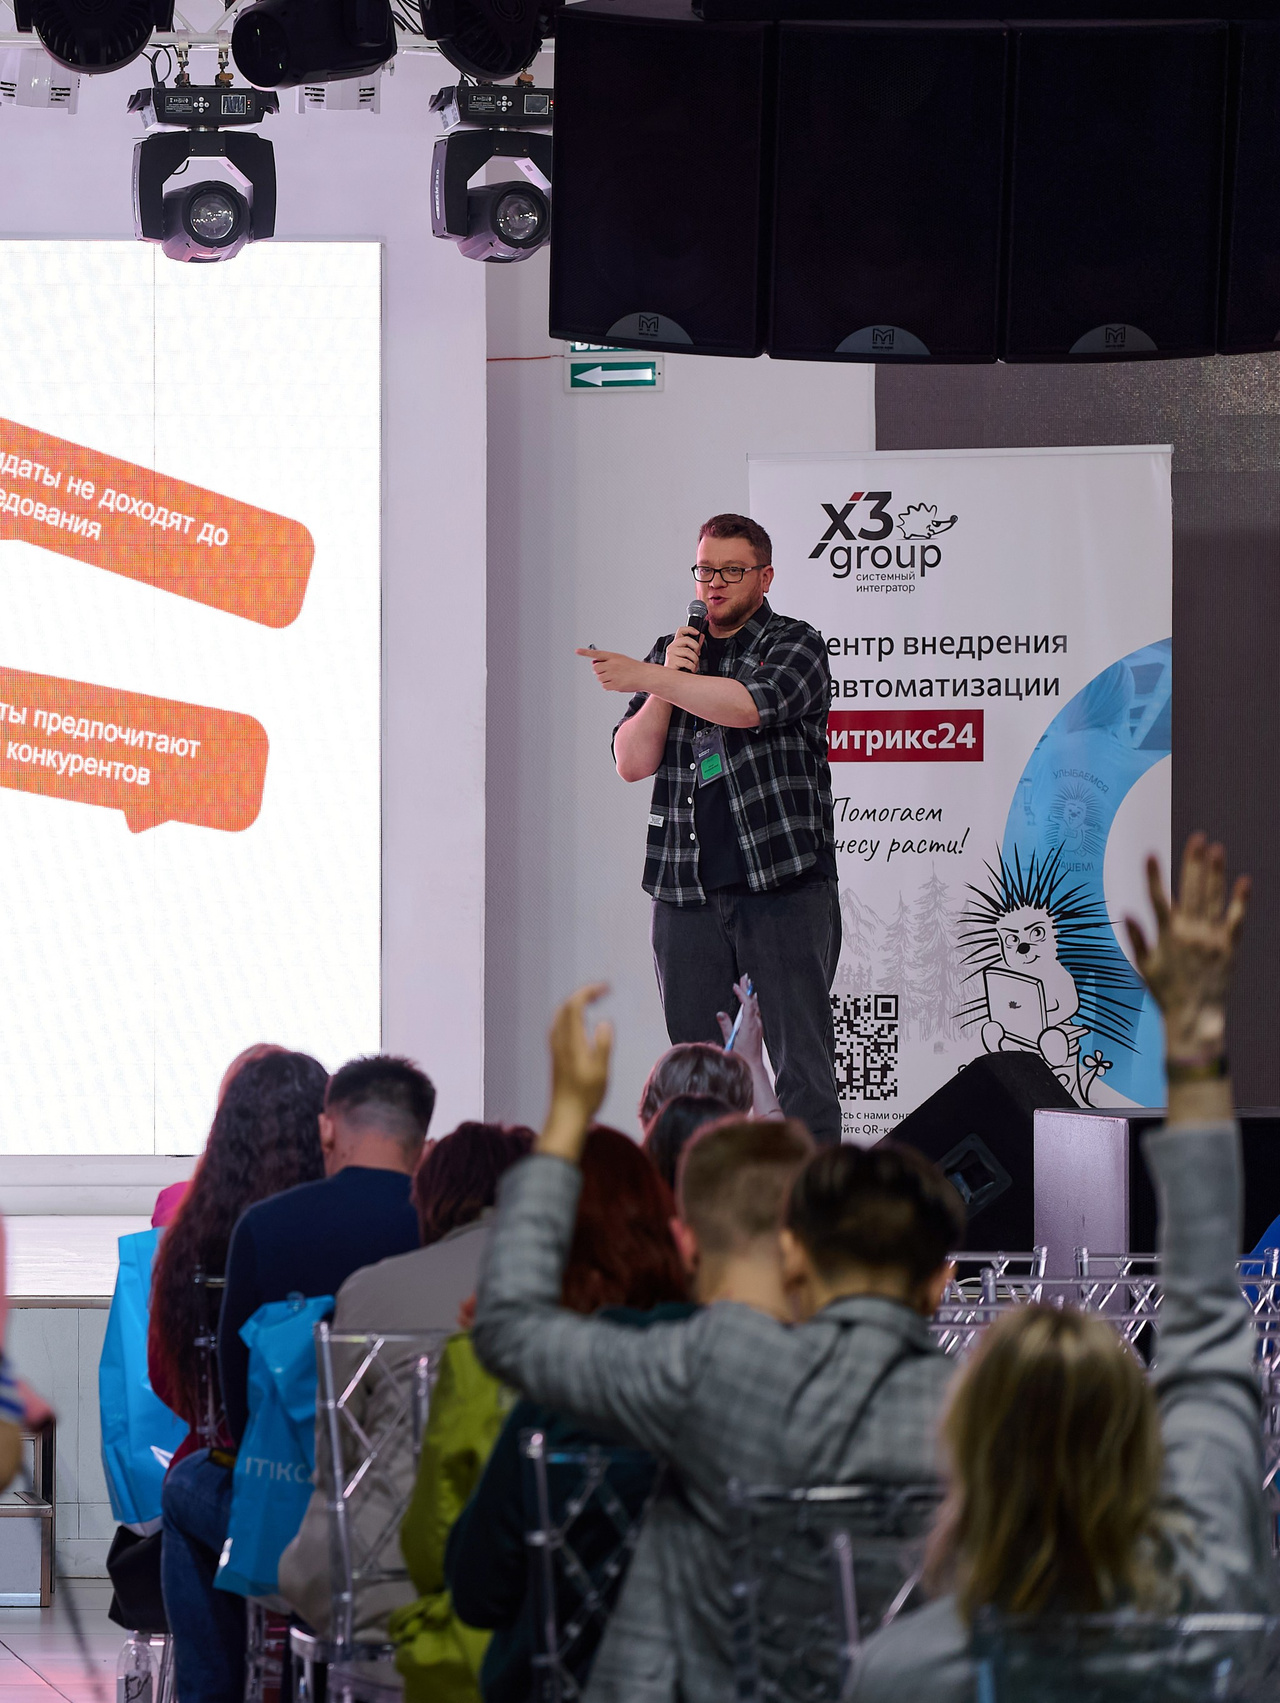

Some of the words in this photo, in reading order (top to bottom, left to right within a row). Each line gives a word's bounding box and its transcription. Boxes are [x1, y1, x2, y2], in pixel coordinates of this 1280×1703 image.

[66, 475, 95, 501] не
[98, 489, 196, 536] доходят
[197, 522, 229, 547] до
[829, 544, 942, 579] group
[856, 571, 916, 582] системный
[856, 584, 916, 594] интегратор
[826, 636, 895, 662] ентр
[903, 634, 1068, 661] внедрения
[829, 677, 1060, 701] автоматизации
[33, 708, 201, 759] предпочитают
[827, 722, 977, 756] итрикс24
[6, 739, 151, 786] конкурентов
[1052, 768, 1110, 793] УЛЫБАЕМСЯ
[832, 796, 943, 822] Помогаем
[834, 838, 881, 862] несу
[886, 827, 970, 863] расти!
[1058, 860, 1095, 872] АШЕМ!
[841, 1123, 861, 1135] йте
[864, 1112, 890, 1120] нами
